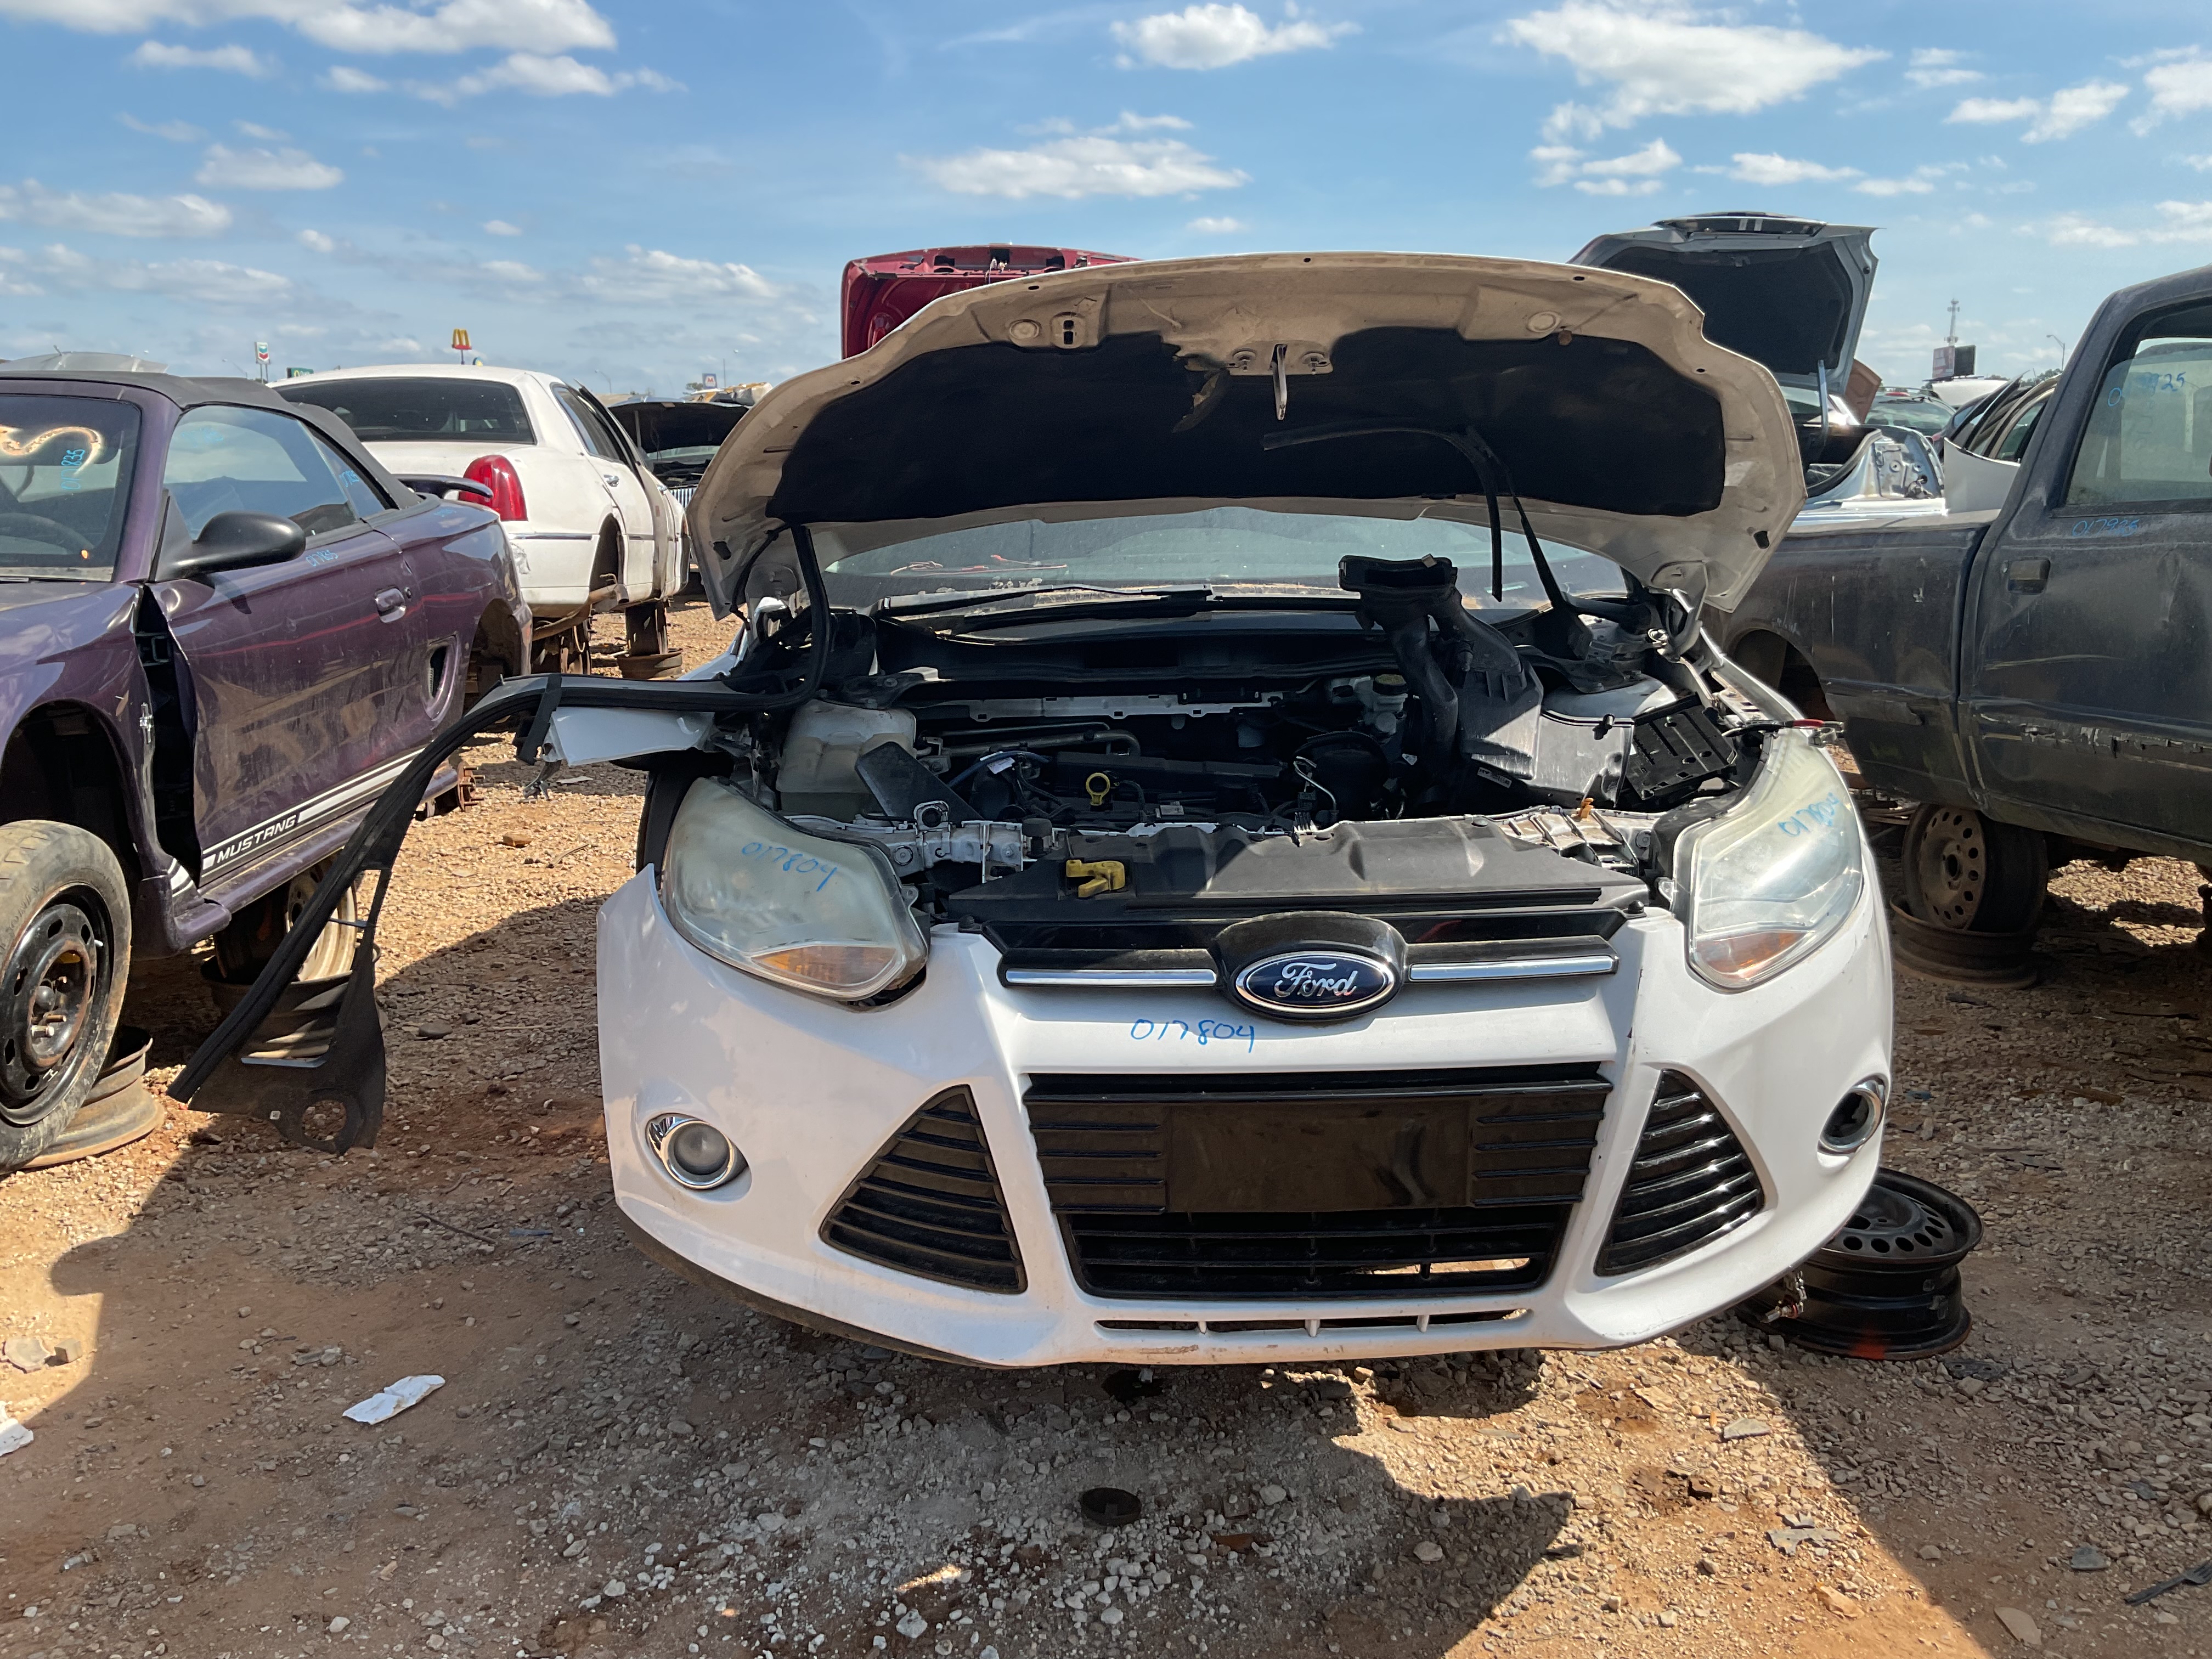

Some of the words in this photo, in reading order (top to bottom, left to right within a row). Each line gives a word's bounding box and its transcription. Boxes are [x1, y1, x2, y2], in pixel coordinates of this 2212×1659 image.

[61, 449, 85, 490] 017835
[2072, 518, 2140, 537] 017925
[306, 549, 338, 567] 017835
[217, 815, 296, 863] MUSTANG
[742, 842, 838, 892] 017804
[1274, 962, 1358, 997] Ford
[1130, 1019, 1255, 1053] 017804
